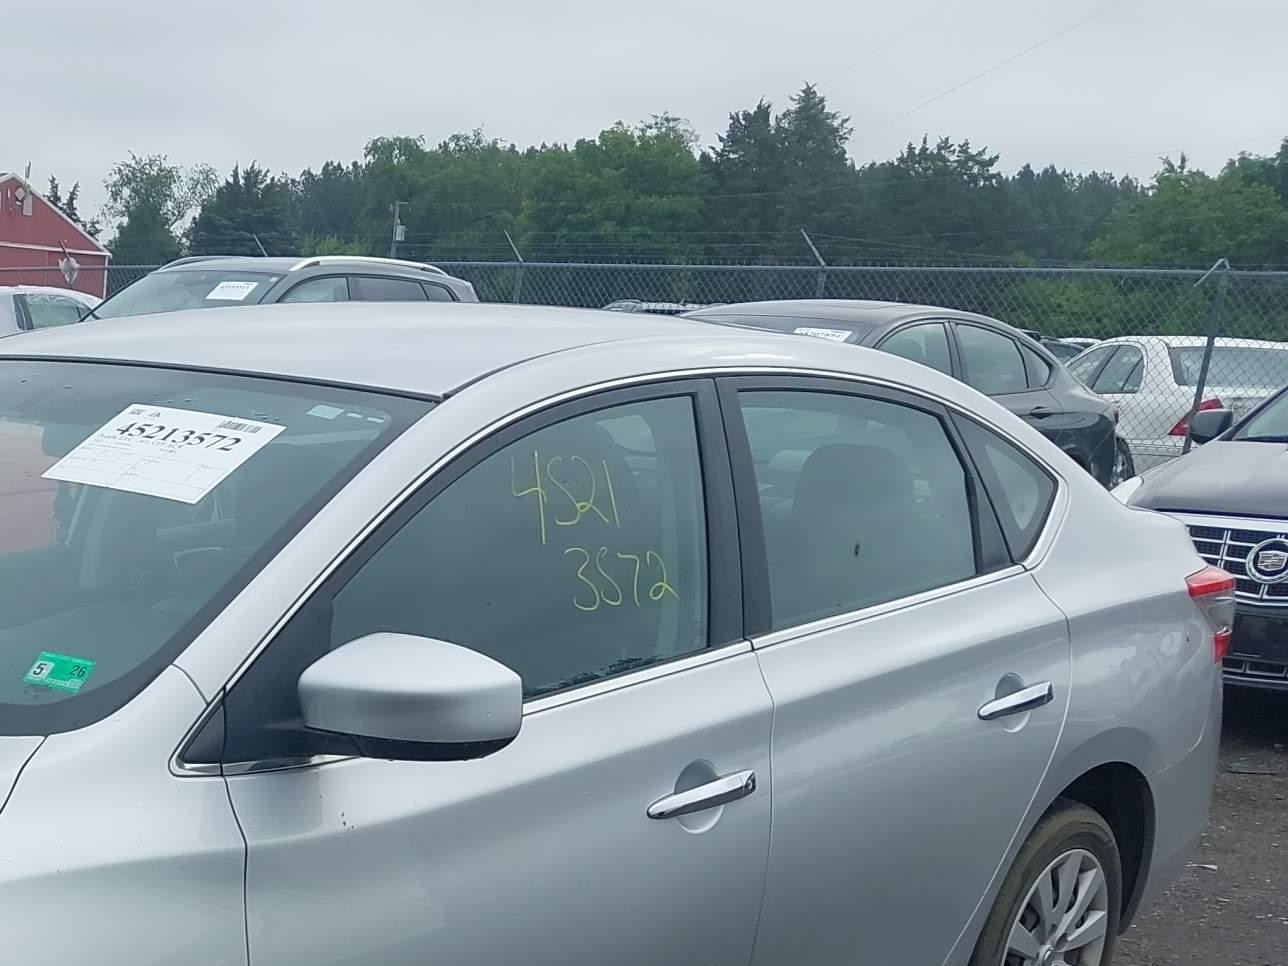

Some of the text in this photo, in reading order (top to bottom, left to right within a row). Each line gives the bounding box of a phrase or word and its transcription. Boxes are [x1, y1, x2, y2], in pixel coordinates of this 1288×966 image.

[115, 421, 243, 452] 45213572
[511, 450, 620, 544] 4521
[564, 546, 680, 611] 3572
[33, 663, 88, 678] 5 26
